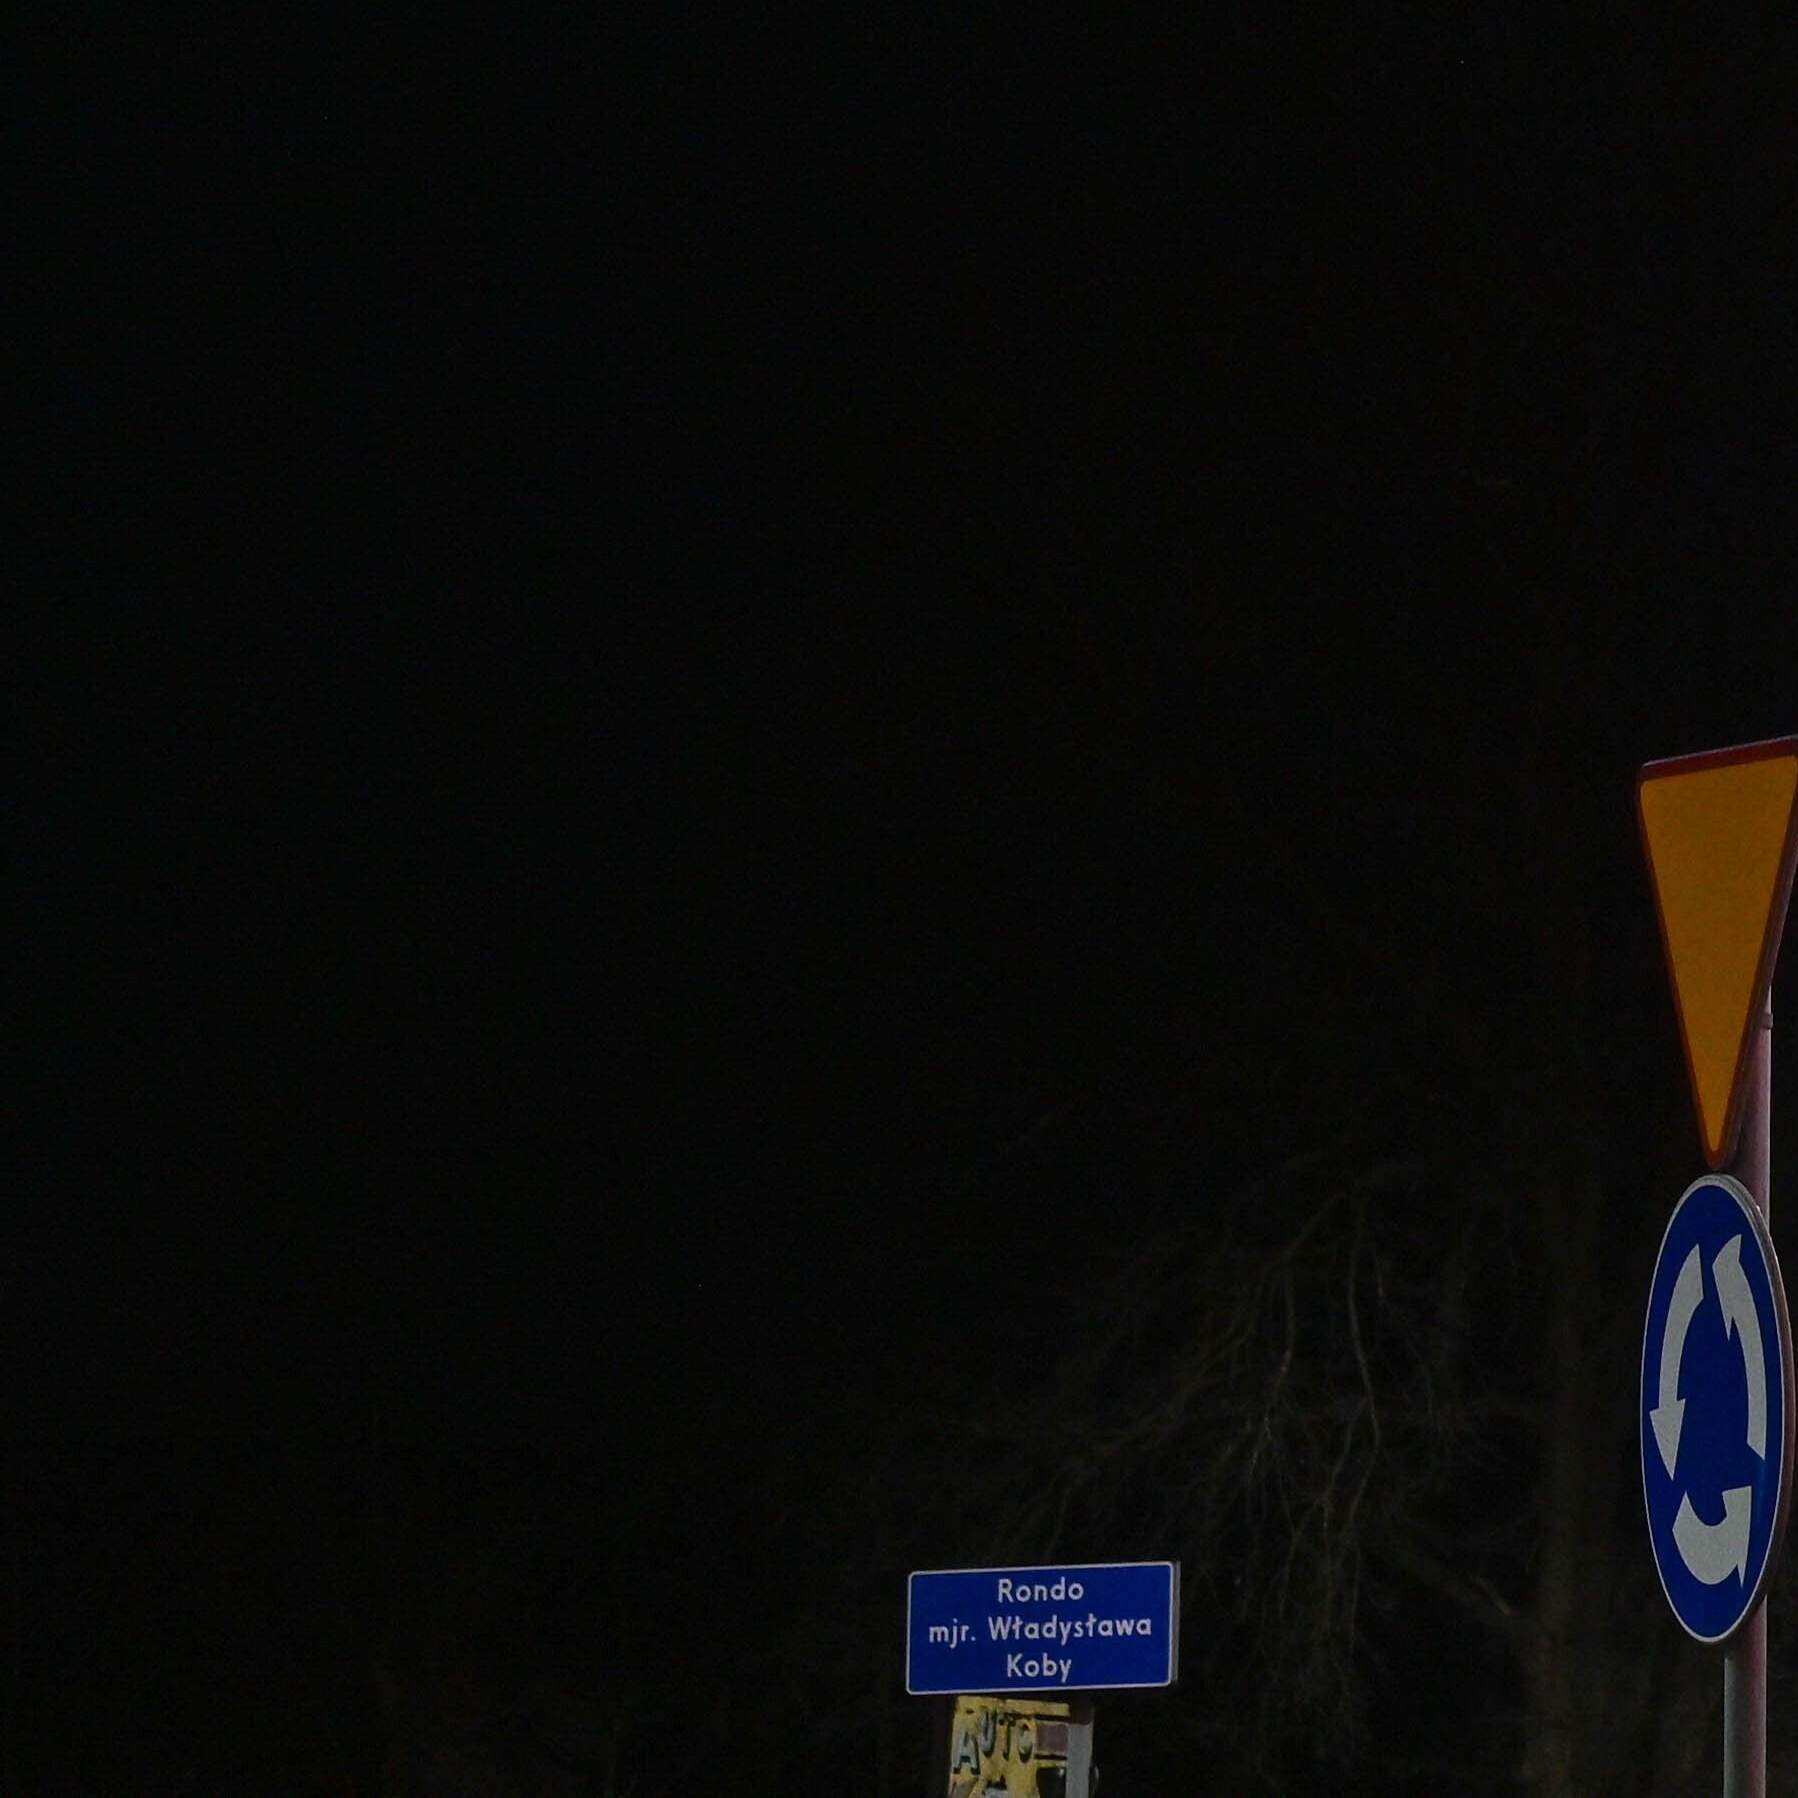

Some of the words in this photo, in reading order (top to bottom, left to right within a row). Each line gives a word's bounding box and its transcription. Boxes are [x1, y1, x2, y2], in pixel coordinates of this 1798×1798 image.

[998, 1576, 1085, 1604] Rondo
[928, 1618, 976, 1648] mjr.
[988, 1613, 1152, 1646] Władysława
[1006, 1652, 1073, 1682] Koby
